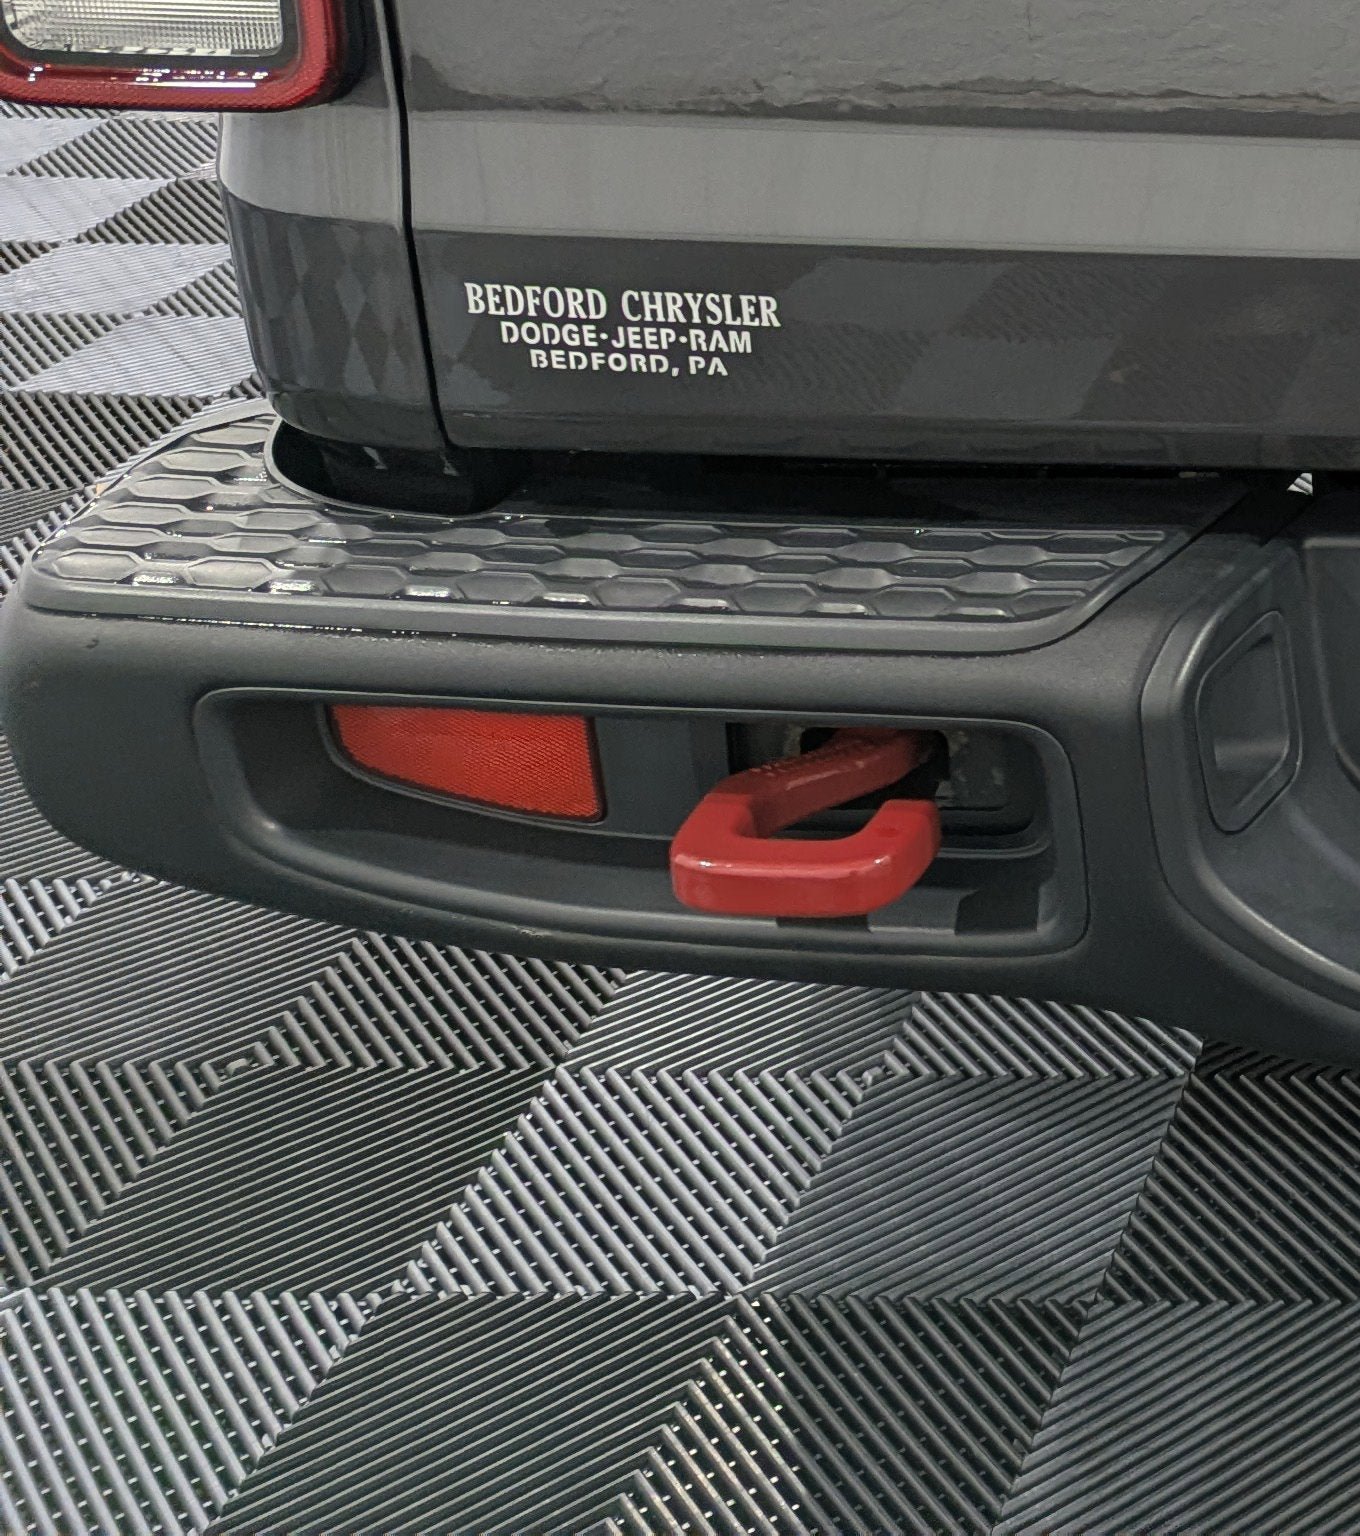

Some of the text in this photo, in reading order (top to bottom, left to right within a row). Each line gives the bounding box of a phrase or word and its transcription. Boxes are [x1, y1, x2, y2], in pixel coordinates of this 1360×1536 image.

[464, 282, 781, 327] BEDFORD CHRYSLER
[529, 349, 729, 377] BEDFORD, PA
